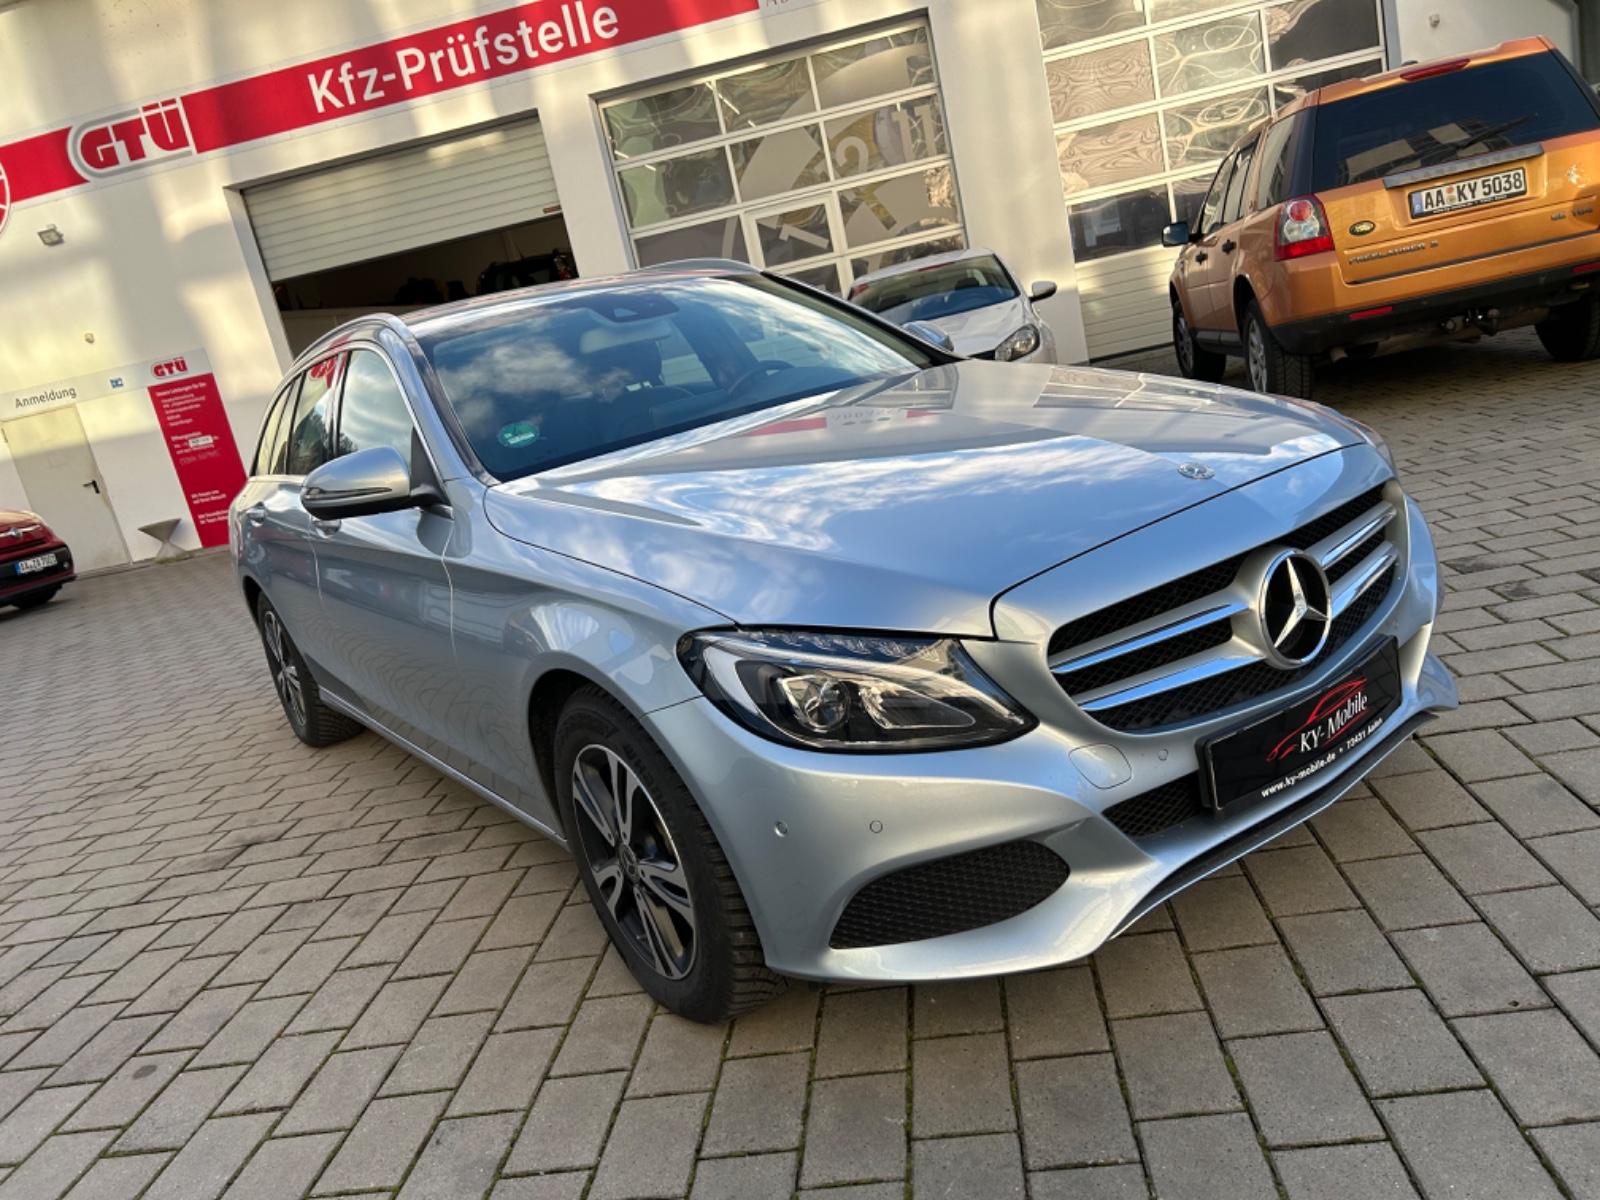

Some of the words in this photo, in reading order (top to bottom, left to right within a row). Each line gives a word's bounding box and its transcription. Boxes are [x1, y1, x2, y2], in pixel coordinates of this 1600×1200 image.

[306, 0, 619, 113] Kfz-Prüfstelle
[79, 98, 190, 171] GTÜ
[1424, 188, 1446, 210] AA
[1456, 181, 1477, 202] KY
[1481, 172, 1523, 196] 5038
[153, 356, 188, 377] GTÜ
[15, 386, 77, 409] Anmeldung
[1261, 752, 1336, 798] www.ky-mobile.de
